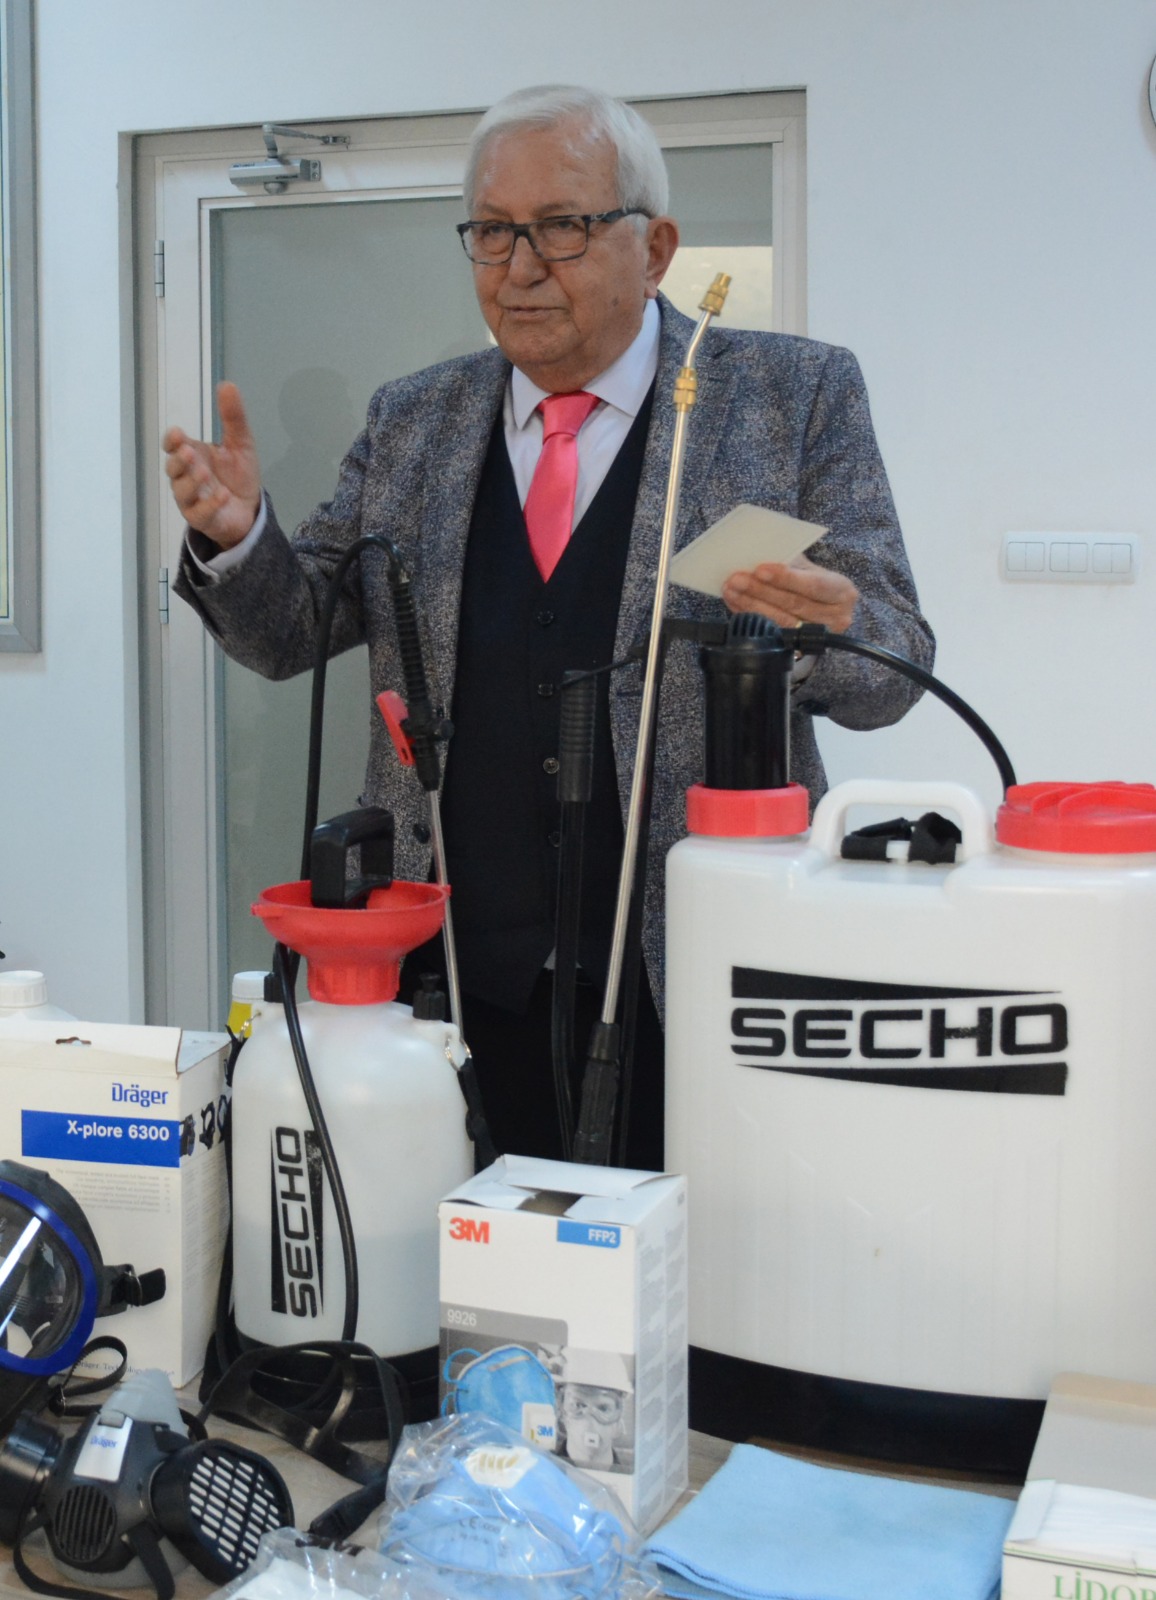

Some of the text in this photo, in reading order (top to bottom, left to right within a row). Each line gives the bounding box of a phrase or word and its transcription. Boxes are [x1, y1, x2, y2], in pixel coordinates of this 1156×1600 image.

[730, 1002, 1068, 1059] SECHO
[111, 1082, 169, 1108] Dräger
[66, 1119, 170, 1142] X-plore 6300
[276, 1126, 317, 1319] SECHO
[448, 1216, 490, 1245] 3M
[587, 1228, 617, 1244] FFP2
[447, 1308, 477, 1326] 9926
[536, 1424, 554, 1438] 3M
